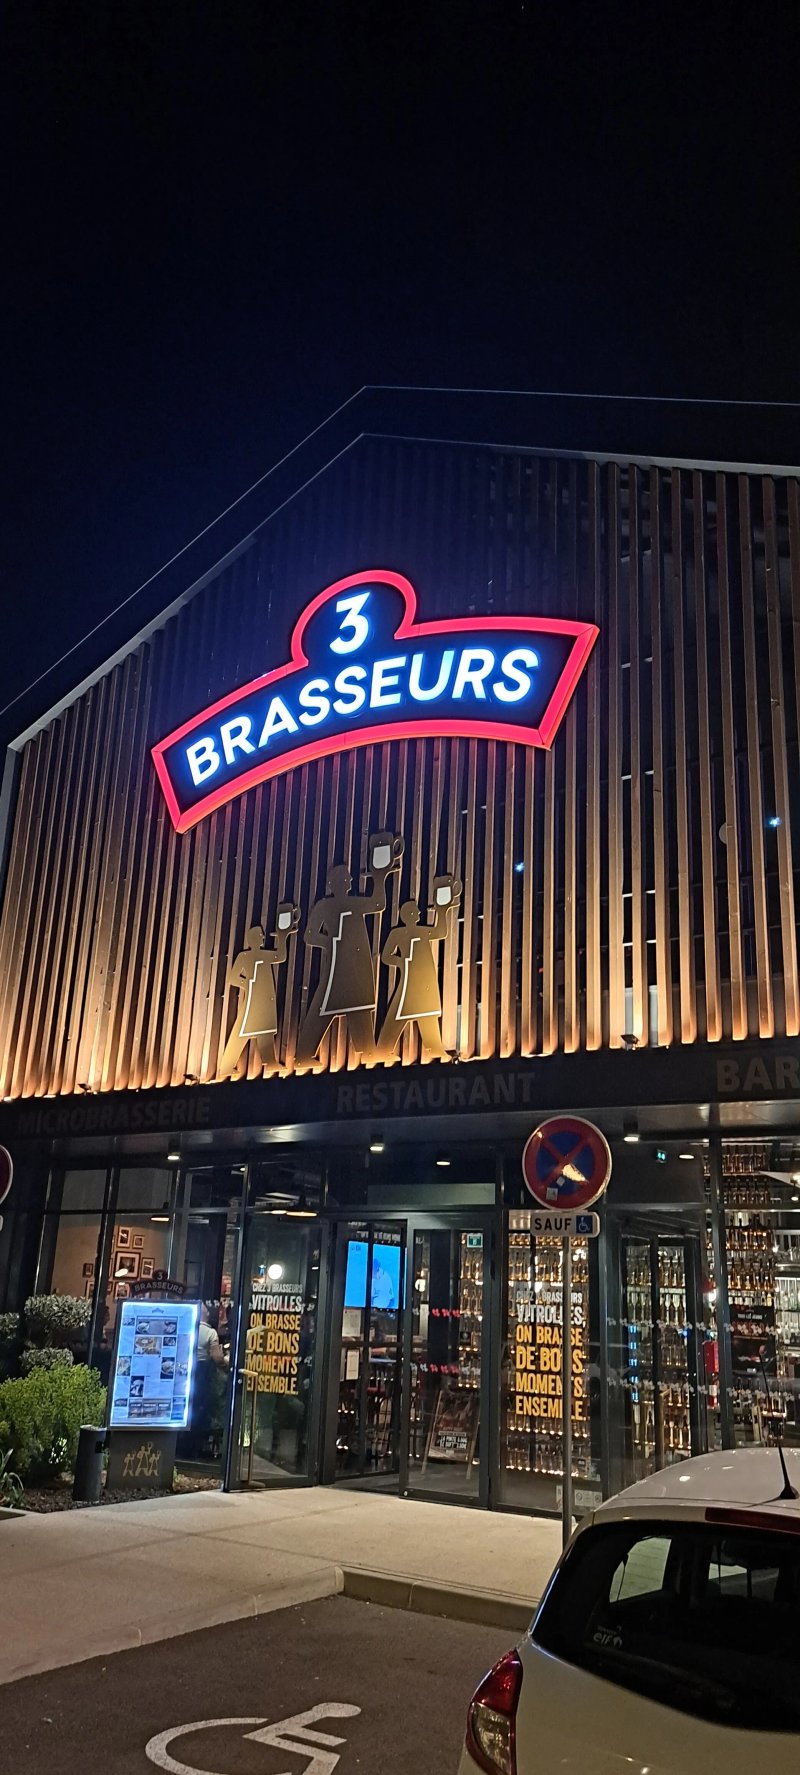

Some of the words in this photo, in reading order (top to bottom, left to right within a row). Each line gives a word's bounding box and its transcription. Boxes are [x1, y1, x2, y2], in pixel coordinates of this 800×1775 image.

[329, 592, 370, 655] 3
[186, 648, 539, 786] BRASSEURS
[716, 1056, 800, 1092] BAR
[336, 1072, 535, 1113] RESTAURANT
[16, 1097, 210, 1135] MICROBRASSERIE
[534, 1217, 572, 1230] SAUF
[157, 1272, 163, 1280] 3
[134, 1281, 183, 1294] BRASSEURS
[252, 1283, 266, 1292] CHEZ
[272, 1283, 303, 1293] BRASSEURS
[252, 1294, 304, 1315] VITROLLES,
[250, 1313, 263, 1328] ON
[266, 1313, 301, 1331] BRASSE
[248, 1332, 264, 1352] DE
[266, 1332, 300, 1354] BONS
[516, 1324, 532, 1343] ON
[247, 1353, 298, 1375] MOMENTS
[516, 1345, 536, 1370] DE
[540, 1347, 584, 1374] BOS
[516, 1372, 583, 1398] MOMENS
[515, 1395, 587, 1421] ENSEME.
[593, 1632, 613, 1644] elf
